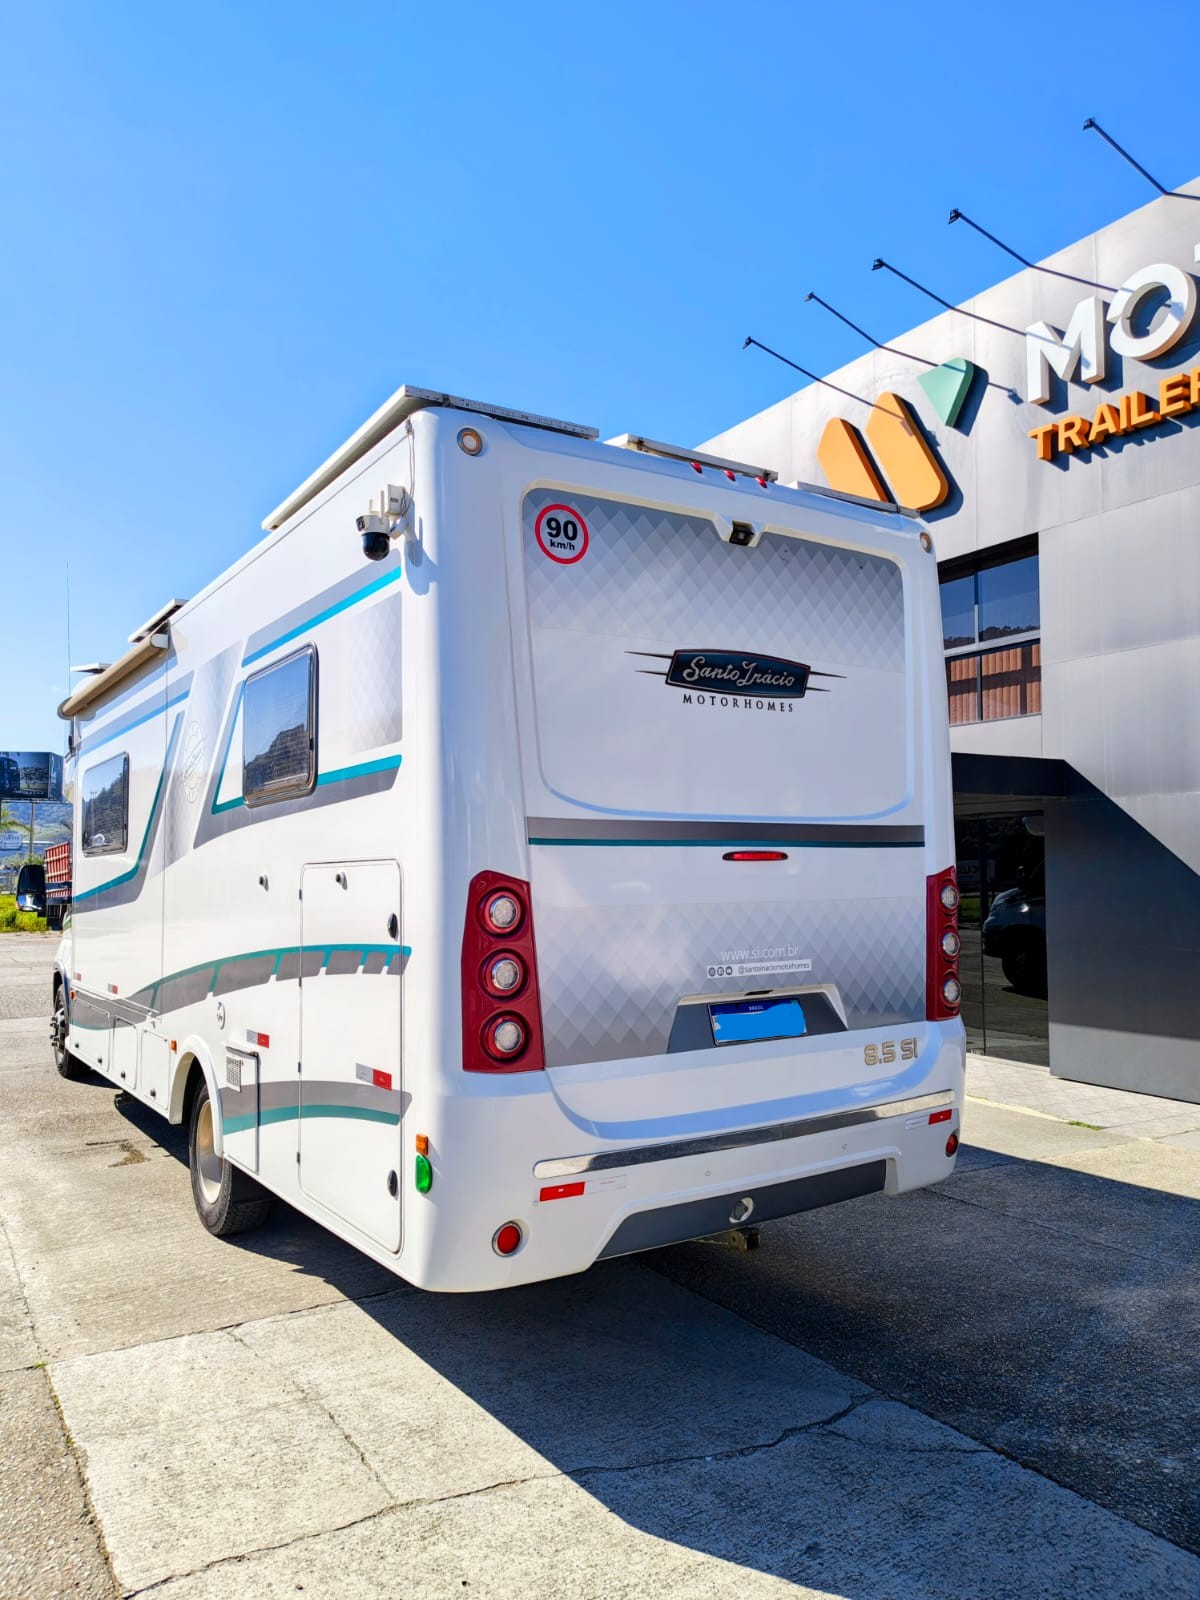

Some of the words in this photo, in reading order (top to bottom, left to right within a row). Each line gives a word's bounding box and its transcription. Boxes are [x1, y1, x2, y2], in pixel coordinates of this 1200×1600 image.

[1026, 244, 1200, 406] MO
[546, 517, 578, 541] 90
[550, 539, 575, 551] km/h
[683, 656, 740, 681] Santo
[682, 693, 793, 712] MOTORHOMES
[720, 944, 799, 960] www.si.com.br
[864, 1041, 896, 1066] 8.5
